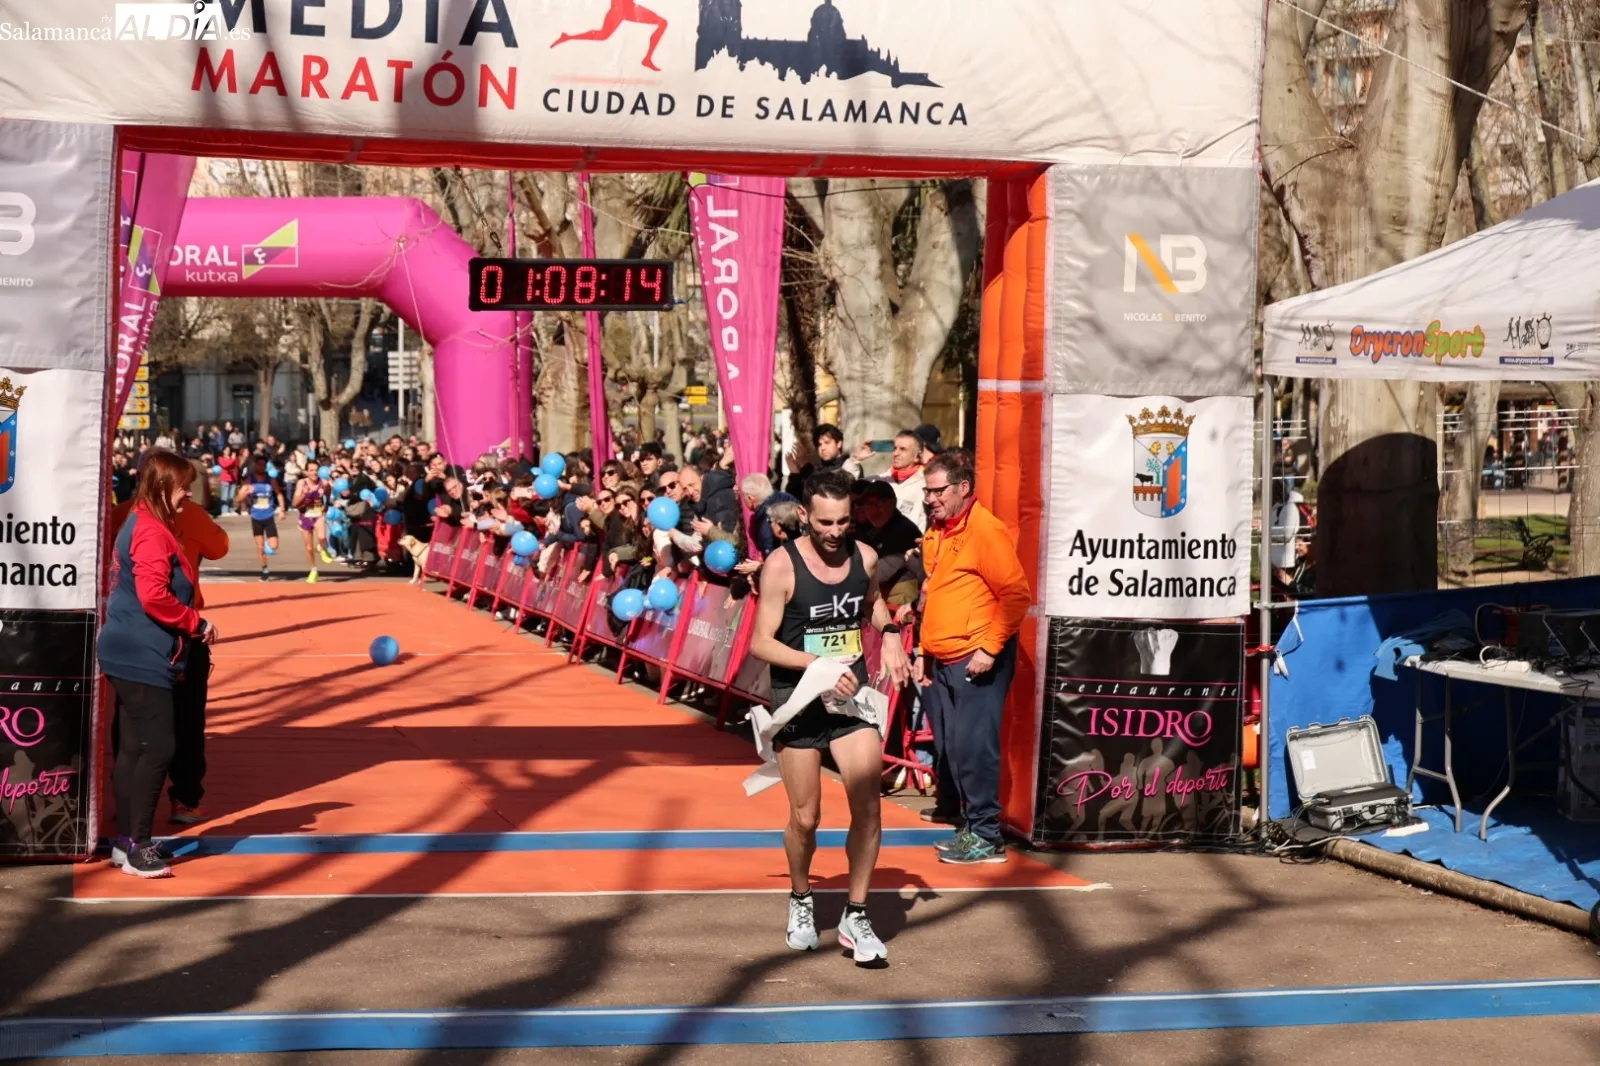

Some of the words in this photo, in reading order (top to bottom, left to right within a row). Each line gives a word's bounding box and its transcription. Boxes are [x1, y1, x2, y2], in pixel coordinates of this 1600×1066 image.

[194, 0, 519, 48] MEDIA
[191, 47, 518, 110] MARATÓN
[542, 88, 676, 116] CIUDAD
[696, 95, 735, 119] DE
[755, 96, 968, 127] SALAMANCA
[185, 268, 239, 283] kutxa
[1123, 312, 1163, 322] NICOLAS
[1174, 313, 1207, 322] BENITO
[0, 512, 76, 545] iento
[1069, 529, 1237, 566] Ayuntamiento
[1068, 567, 1099, 596] de
[1107, 568, 1237, 598] Salamanca
[810, 592, 864, 618] EKT
[821, 633, 847, 648] 721
[1059, 681, 1238, 698] restaurante
[1086, 707, 1213, 747] ISIDRO
[1056, 770, 1135, 814] Por
[1144, 767, 1160, 798] el
[1166, 764, 1235, 807] deporte
